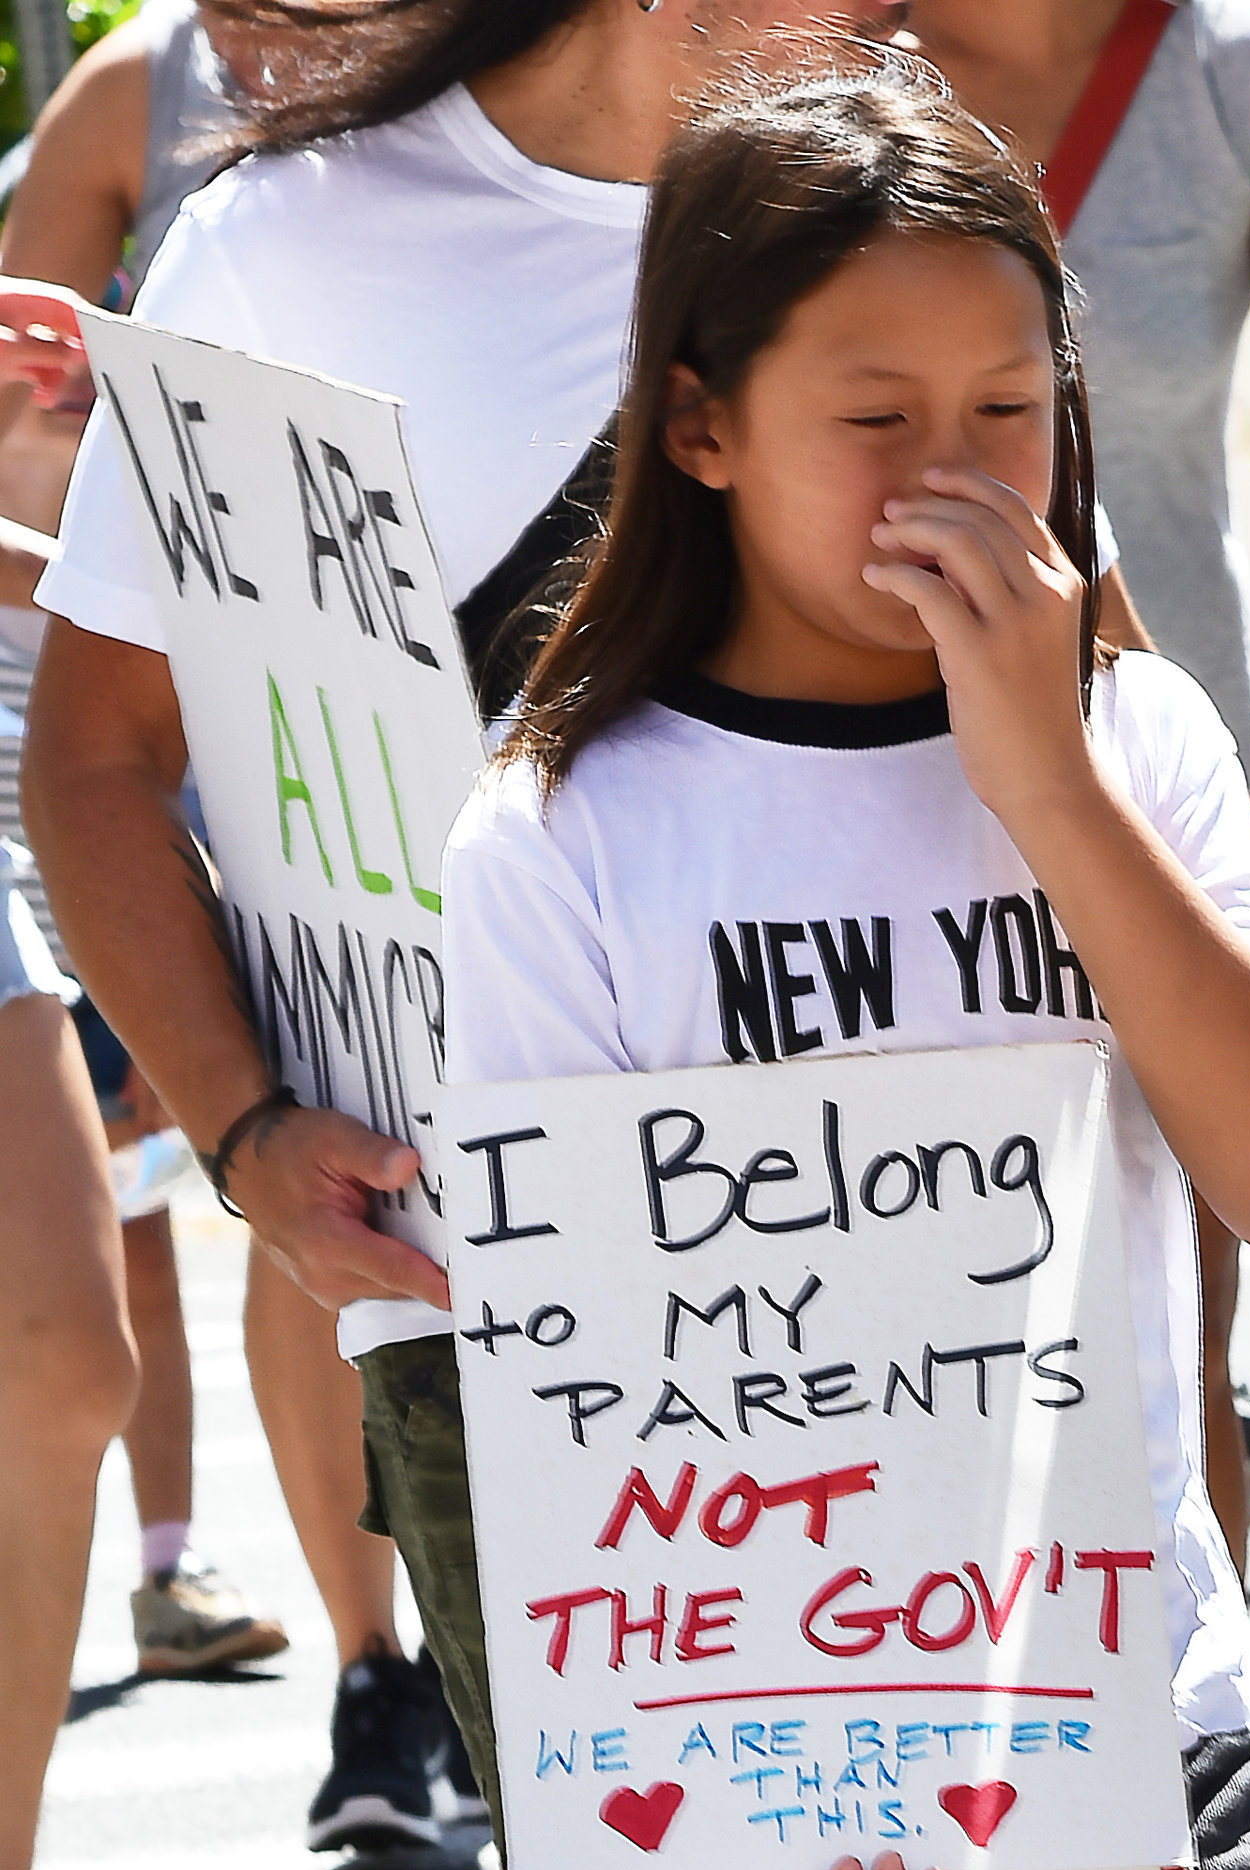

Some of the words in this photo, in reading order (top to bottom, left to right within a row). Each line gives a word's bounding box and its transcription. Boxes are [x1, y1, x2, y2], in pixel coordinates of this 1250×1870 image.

[103, 363, 260, 605] WE
[285, 417, 442, 672] ARE
[265, 667, 443, 916] ALL
[709, 916, 895, 1063] NEW
[931, 888, 1110, 1025] YOR
[456, 1127, 558, 1247] I
[637, 1099, 1056, 1285] Belong
[460, 1299, 577, 1355] to
[664, 1273, 824, 1360] MY
[532, 1337, 1087, 1447] PARENTS
[595, 1460, 881, 1552] NOT
[526, 1583, 746, 1678] THE
[800, 1541, 1156, 1657] GOV'T
[535, 1728, 631, 1780] WE
[678, 1719, 808, 1764] ARE
[845, 1718, 1094, 1765] BETTER
[730, 1757, 903, 1799] THAN
[746, 1799, 926, 1843] THIS.
